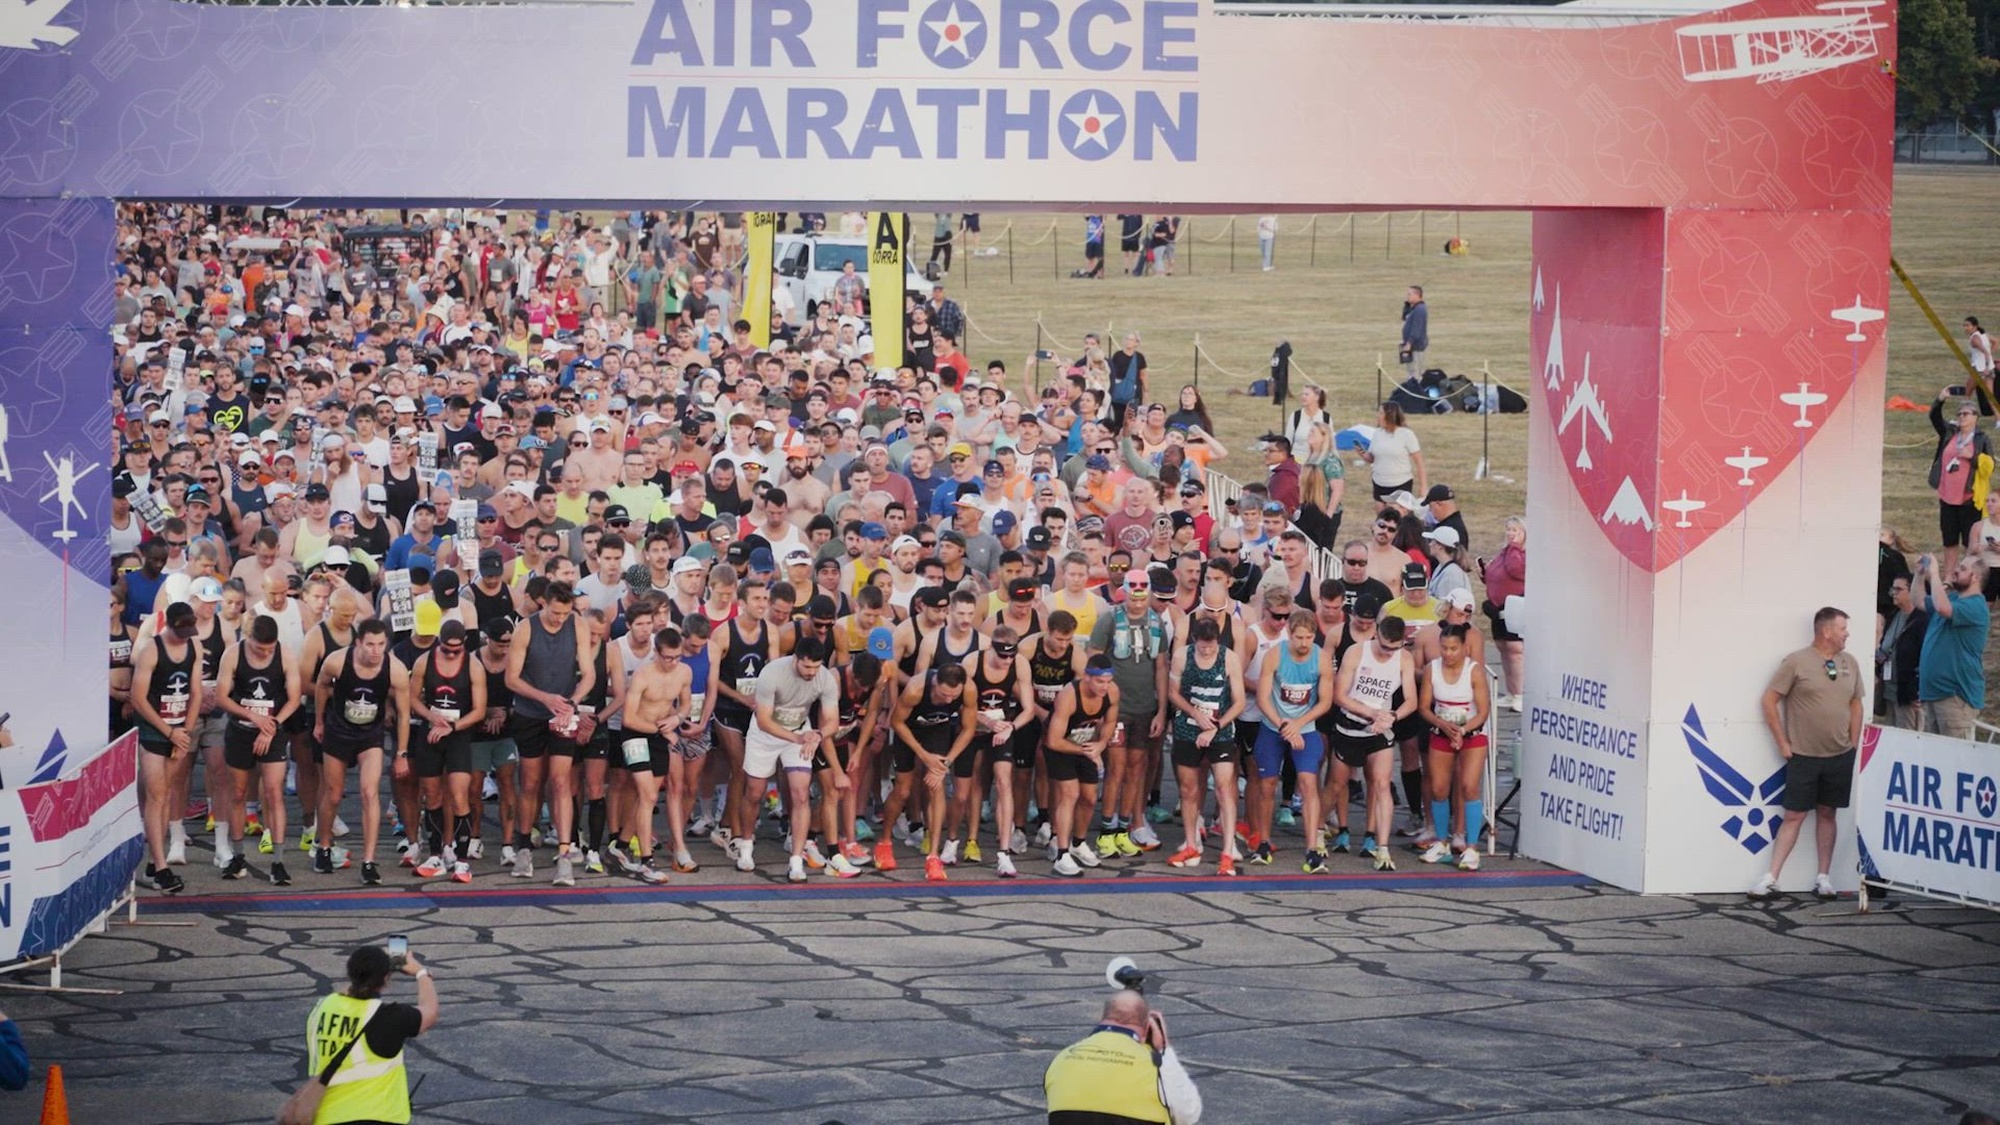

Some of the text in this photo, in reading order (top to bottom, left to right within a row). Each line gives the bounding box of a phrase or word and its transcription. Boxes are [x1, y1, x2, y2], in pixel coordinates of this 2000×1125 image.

[630, 0, 1199, 71] AIR FORCE
[626, 84, 1199, 162] MARATHON
[1356, 684, 1390, 700] FORCE
[1359, 675, 1392, 690] SPACE
[1561, 673, 1607, 711] WHERE
[1530, 706, 1638, 760] PERSEVERANCE
[1548, 753, 1617, 797] AND PRIDE
[1886, 761, 1943, 811] AIR
[1540, 791, 1623, 841] TAKE FLIGHT!
[317, 1012, 360, 1038] AFM
